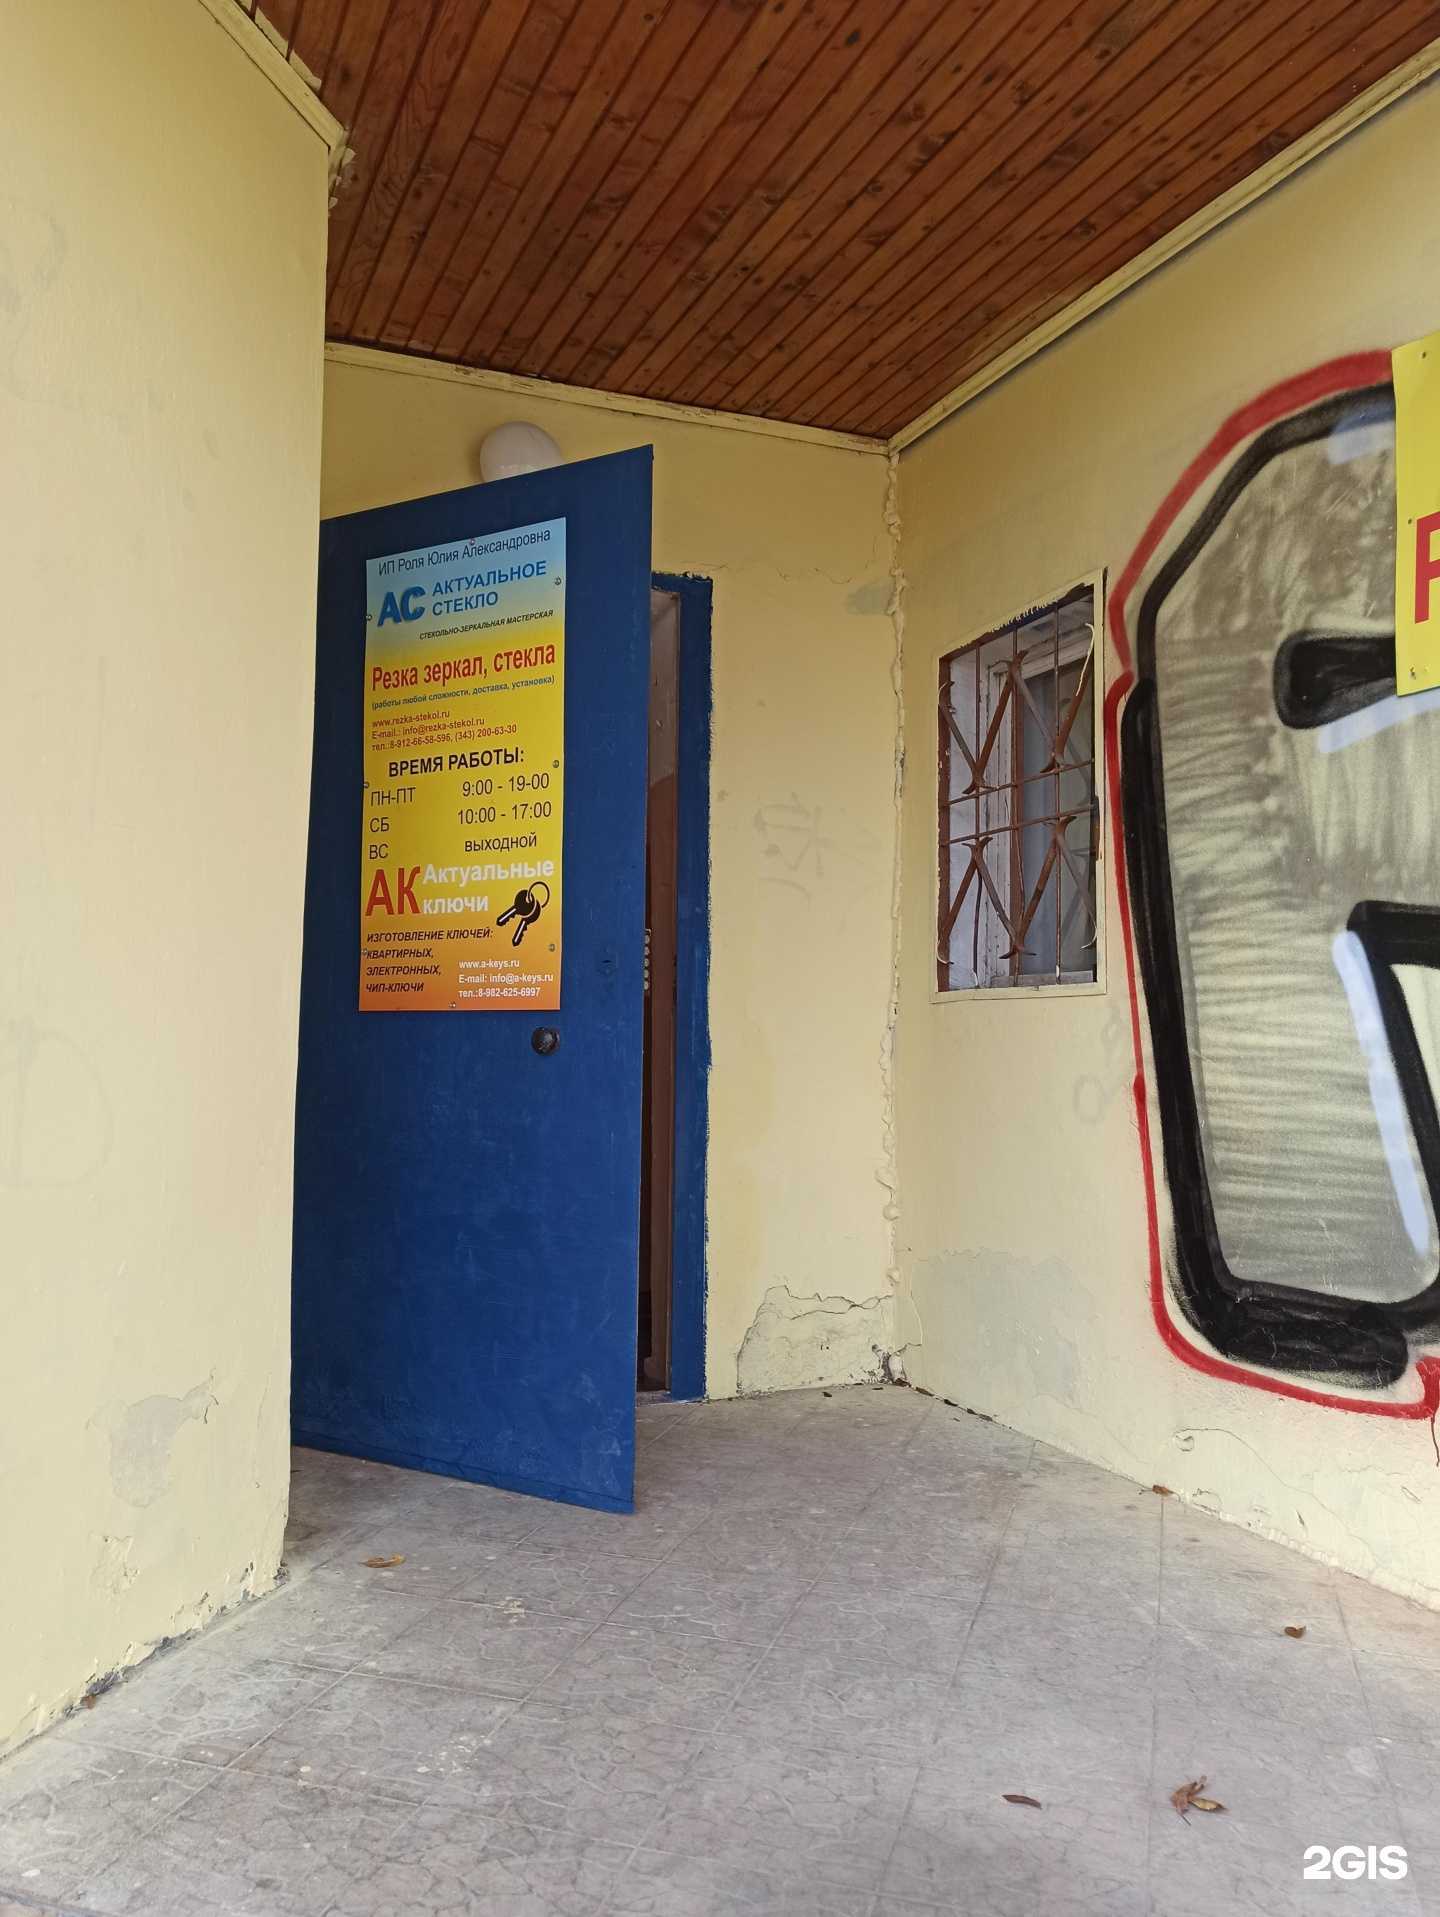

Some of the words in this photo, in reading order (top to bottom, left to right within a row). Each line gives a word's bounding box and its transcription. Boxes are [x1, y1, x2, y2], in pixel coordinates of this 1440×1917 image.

[378, 560, 395, 577] ИП
[398, 556, 424, 573] Роля
[427, 549, 459, 566] Юлия
[462, 529, 550, 559] Александровна
[432, 560, 547, 596] АКТУАЛЬНОЕ
[377, 585, 425, 627] АС
[432, 591, 498, 616] СТЕКЛО
[420, 618, 505, 640] СТЕКОЛЬНО-ЗЕРКАЛЬНАЯ
[506, 609, 554, 625] МАСТЕРСКАЯ
[372, 666, 418, 691] Резка
[423, 655, 488, 687] зеркал,
[493, 644, 555, 673] стекла
[372, 711, 450, 728] www.rezka-stekol.ru
[455, 730, 475, 742] (343)
[477, 724, 517, 738] 200-63-30
[388, 756, 443, 777] ВРЕМЯ
[448, 746, 525, 770] РАБОТЫ:
[370, 787, 416, 806] ПН-ПТ
[462, 778, 493, 796] 9:00
[508, 772, 550, 792] 19-00
[369, 817, 390, 833] СБ
[457, 806, 496, 825] 10:00
[511, 801, 551, 820] 17:00
[369, 843, 389, 860] ВС
[422, 860, 555, 887] Актуальные
[365, 866, 421, 916] АК
[423, 895, 489, 915] ключи
[367, 930, 444, 943] ИЗГОТОВЛЕНИЕ
[446, 927, 494, 940] КЛЮЧЕЙ:
[366, 948, 434, 959] КВАРТИРНЫХ,
[458, 958, 520, 969] www.a-keys.ru
[366, 965, 441, 976] ЭЛЕКТРОННЫХ,
[458, 973, 488, 983] E-mail:
[489, 973, 554, 984] info@a-keys.ru
[366, 982, 424, 993] ЧИП-КЛЮЧИ
